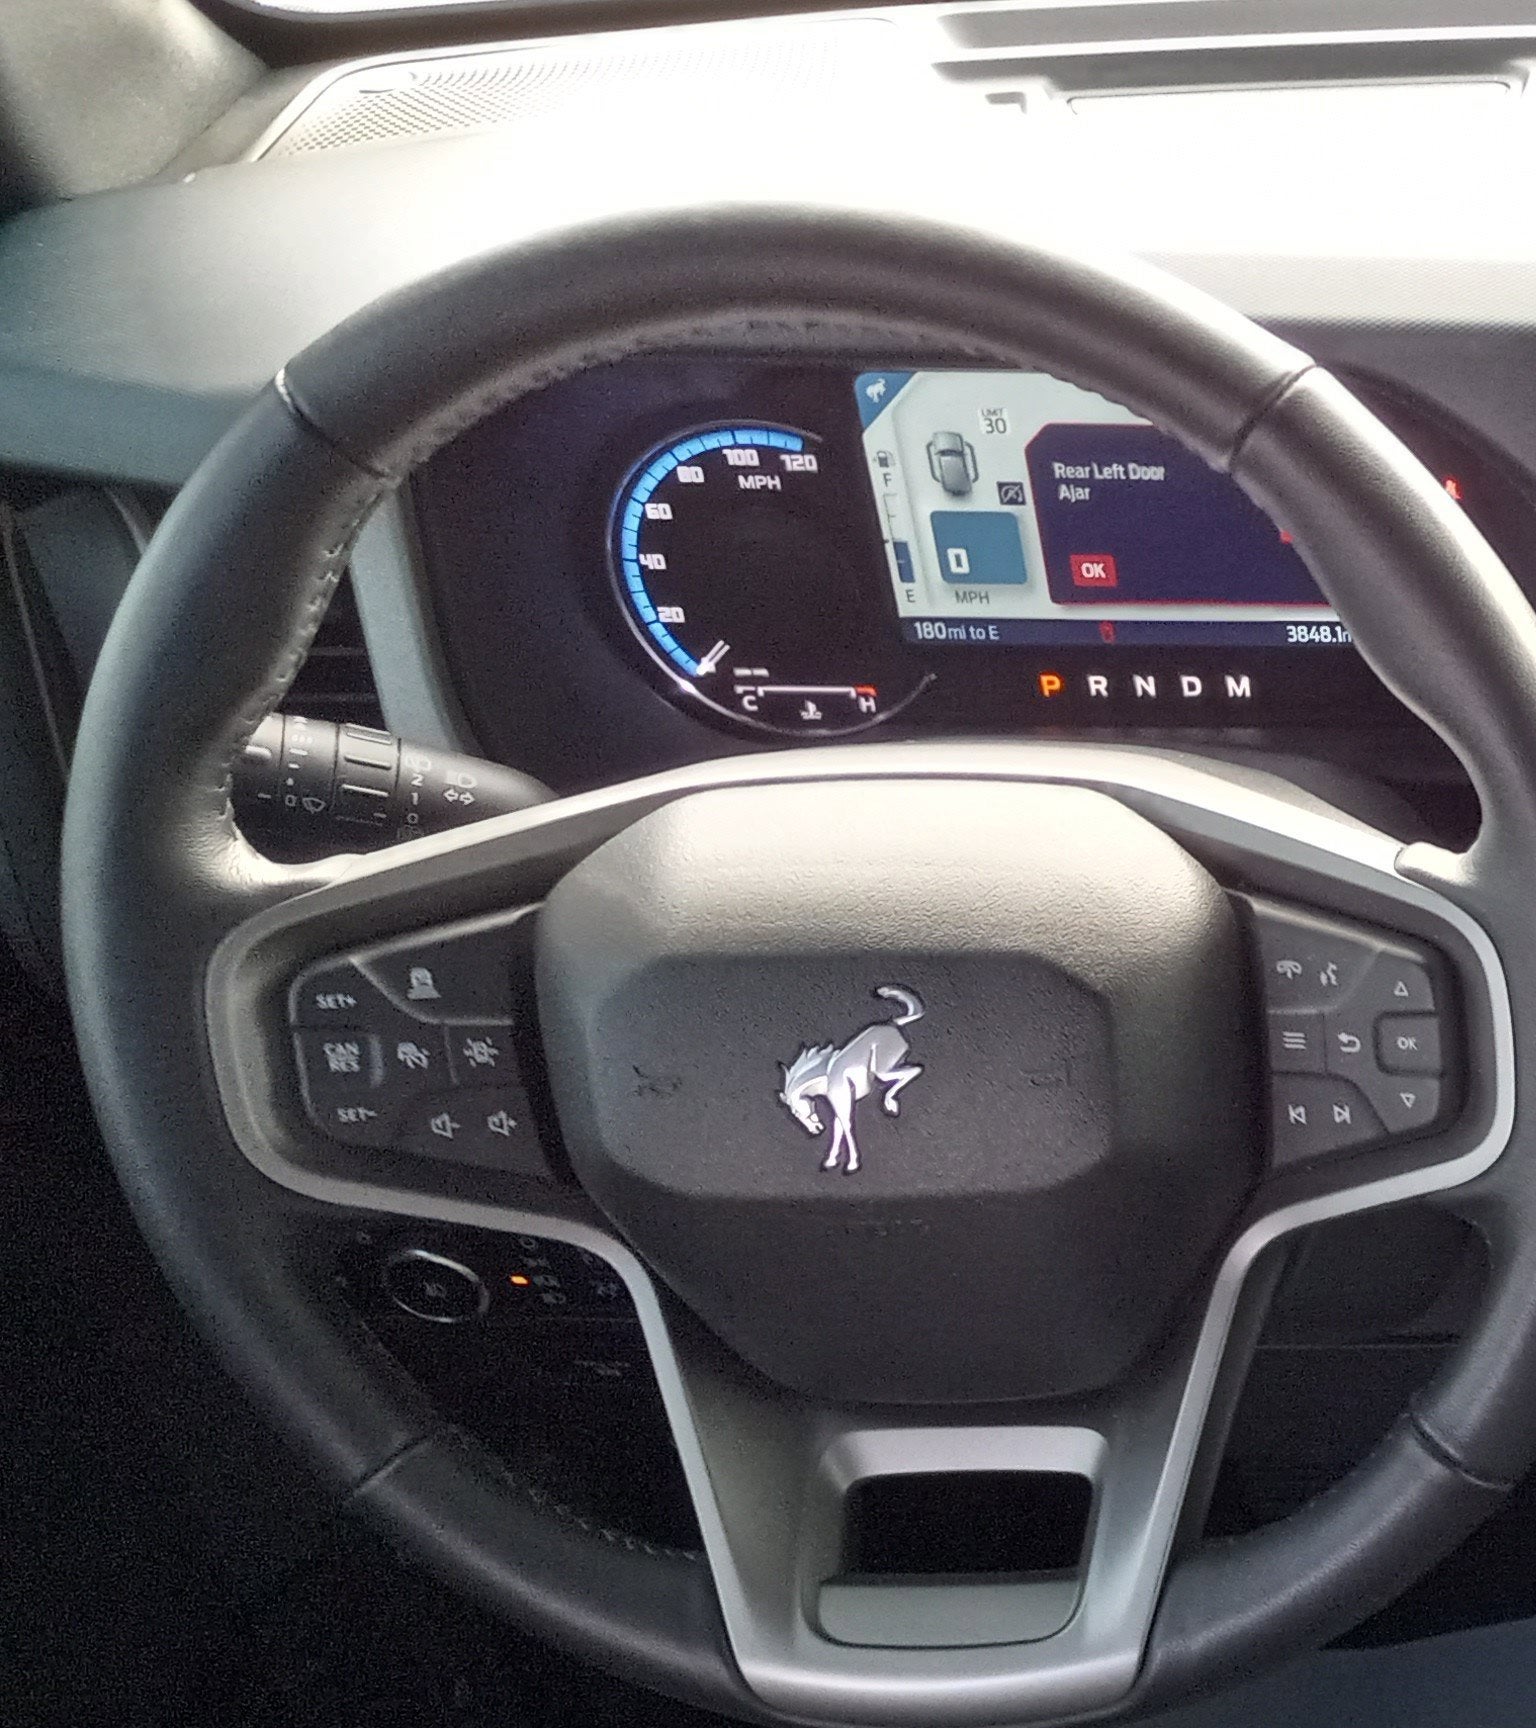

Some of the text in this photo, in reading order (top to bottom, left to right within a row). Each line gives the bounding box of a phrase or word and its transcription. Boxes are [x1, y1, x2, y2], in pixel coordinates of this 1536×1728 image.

[984, 418, 1007, 434] 30
[722, 449, 760, 466] 100
[780, 454, 818, 473] 120
[1054, 462, 1165, 481] Rear Left Door
[738, 475, 782, 491] MPH
[882, 473, 892, 487] F
[1058, 484, 1090, 502] Ajar
[644, 503, 673, 520] 60
[638, 553, 666, 570] 40
[947, 548, 970, 574] 0
[1081, 562, 1106, 579] OK
[905, 589, 915, 603] E
[954, 590, 990, 605] MPH
[657, 606, 685, 623] 20
[970, 625, 986, 640] to
[988, 625, 1000, 640] E
[1039, 674, 1252, 698] P R N D M
[741, 696, 758, 711] C
[858, 697, 876, 713] H
[411, 773, 424, 787] 2
[1396, 1036, 1418, 1051] OK
